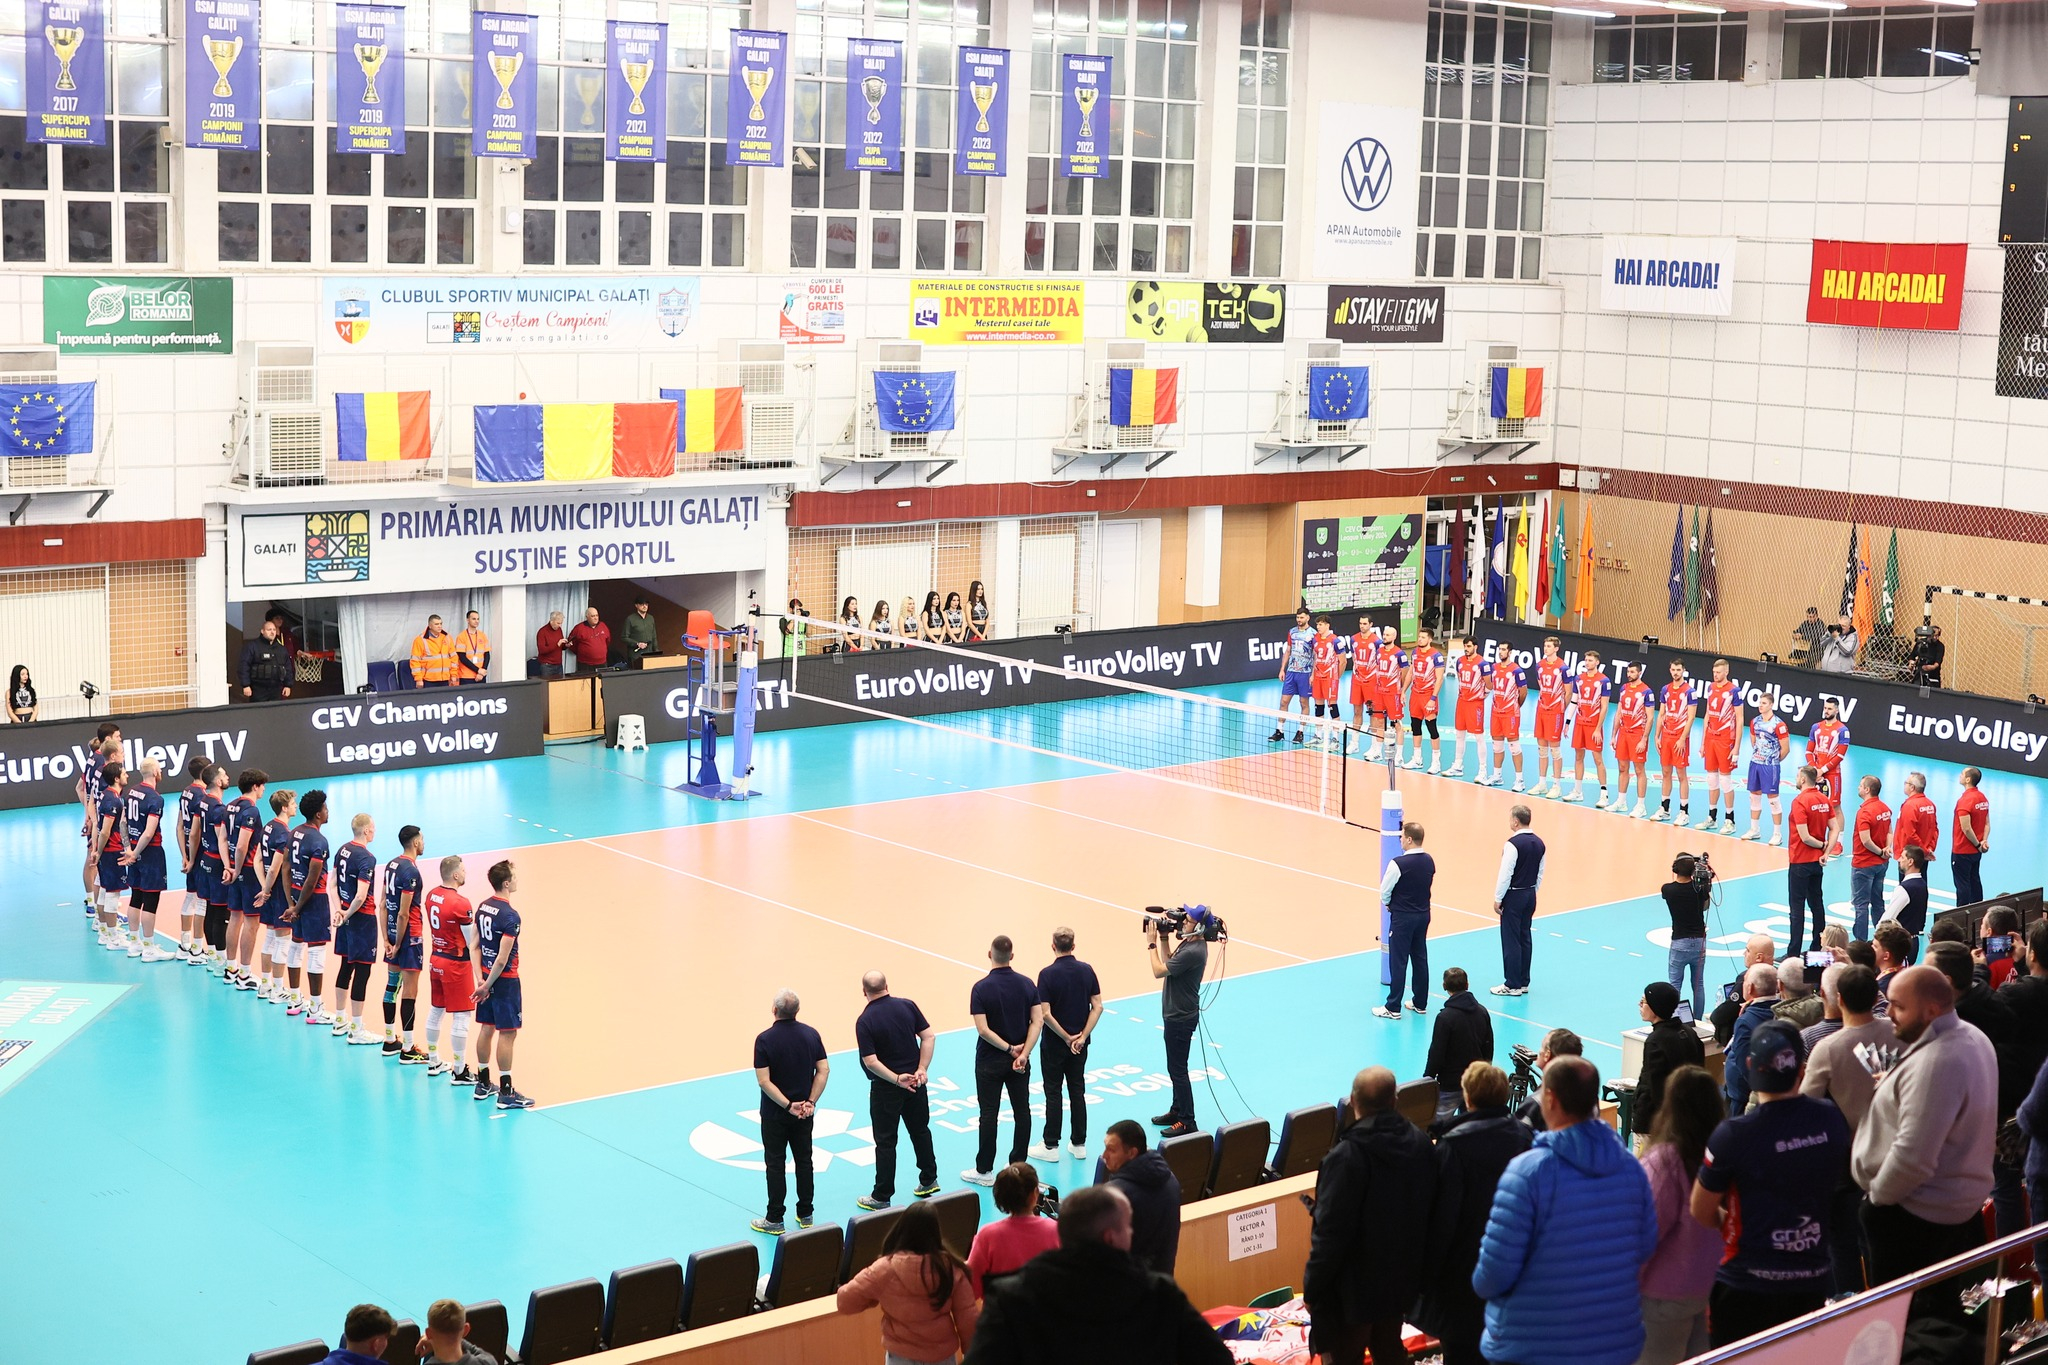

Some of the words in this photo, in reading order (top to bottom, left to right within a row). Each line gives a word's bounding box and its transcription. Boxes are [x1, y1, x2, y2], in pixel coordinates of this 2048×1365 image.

[194, 1, 217, 14] CSM
[216, 2, 249, 17] ARCADA
[345, 10, 365, 23] CSM
[364, 12, 396, 25] ARCADA
[481, 18, 500, 32] CSM
[499, 20, 530, 34] ARCADA
[615, 27, 632, 40] CSM
[631, 28, 660, 42] ARCADA
[736, 35, 754, 48] CSM
[753, 37, 780, 50] ARCADA
[854, 44, 870, 56] CSM
[870, 45, 896, 58] ARCADA
[965, 52, 981, 63] CSM
[980, 53, 1004, 66] ARCADA
[1069, 59, 1083, 70] CSM
[1083, 60, 1106, 73] ARCADA
[53, 96, 78, 111] 2017
[209, 103, 234, 118] 2019
[41, 114, 90, 126] SUPERCUPA
[359, 109, 383, 123] 2019
[493, 114, 516, 128] 2020
[45, 126, 87, 139] ROMÂNIEI
[201, 119, 242, 132] CAMPIONII
[349, 125, 392, 136] SUPERCUPA
[626, 119, 646, 133] 2021
[745, 126, 767, 139] 2022
[202, 132, 241, 144] ROMÂNIEI
[352, 137, 389, 148] ROMÂNIEI
[486, 130, 522, 141] CAMPIONII
[619, 135, 653, 145] CAMPIONII
[863, 131, 882, 144] 2022
[487, 140, 521, 152] ROMÂNIEI
[739, 140, 772, 150] CAMPIONII
[865, 145, 881, 155] CUPA
[972, 137, 991, 150] 2023
[1076, 141, 1094, 153] 2023
[619, 146, 652, 157] ROMÂNIEI
[740, 151, 771, 161] ROMÂNIEI
[967, 151, 996, 161] CAMPIONII
[858, 155, 887, 166] ROMÂNIEI
[967, 161, 995, 171] ROMÂNIEI
[1069, 154, 1100, 164] SUPERCUPA
[1072, 164, 1098, 174] ROMÂNIEI
[1327, 224, 1350, 236] APAN
[1353, 225, 1401, 238] Automobile
[1615, 258, 1642, 286] HAI
[1645, 259, 1720, 290] ARCADA!
[809, 285, 826, 294] 600
[829, 285, 844, 294] LEI
[918, 283, 963, 291] MATERIALE
[1046, 284, 1080, 292] FINISAJE
[1821, 268, 1856, 300] HAI
[1857, 271, 1946, 304] ARCADA!
[131, 291, 191, 307] BELOR
[382, 290, 444, 303] CLUBUL
[448, 290, 513, 303] SPORTIV
[517, 289, 594, 302] MUNICIPAL
[599, 289, 650, 305] GALAȚI
[808, 301, 844, 311] GRATIS
[945, 297, 1080, 317] INTERMEDIA
[1206, 299, 1247, 325] TEK
[1347, 297, 1439, 325] STAYFITGYM
[133, 309, 190, 320] ROMANIA
[546, 309, 611, 334] Campioni!
[1013, 319, 1033, 327] casei
[1035, 319, 1051, 327] tale
[56, 331, 112, 347] Împreună
[113, 333, 151, 347] pentru
[966, 331, 1055, 341] www.intermedia-co.ro
[381, 502, 503, 540] PRIMĂRIA
[511, 499, 673, 534] MUNICIPIULUI
[680, 496, 759, 531] GALAȚI
[254, 543, 296, 556] GALAȚI
[475, 546, 567, 579] SUSȚINE
[578, 541, 675, 568] SPORTUL
[1063, 645, 1186, 680] EuroVolley
[1190, 641, 1223, 667] TV
[1359, 649, 1367, 660] 11
[1380, 660, 1388, 671] 10
[855, 664, 994, 701] EuroVolley
[999, 658, 1034, 686] TV
[1461, 670, 1470, 682] 18
[1583, 686, 1590, 698] 3
[1711, 698, 1718, 709] 4
[311, 705, 362, 730] CEV
[369, 695, 508, 725] Champions
[1888, 703, 2048, 763] EuroVolley
[197, 730, 248, 764] TV
[326, 739, 416, 765] League
[422, 729, 499, 754] Volley
[128, 798, 139, 821] 10
[262, 834, 269, 857] 5
[292, 841, 300, 864] 2
[340, 859, 347, 883] 3
[386, 870, 396, 895] 14
[431, 905, 440, 930] 6
[479, 914, 493, 941] 18
[1235, 1209, 1263, 1221] CATEGORIA
[1239, 1221, 1260, 1233] SECTOR
